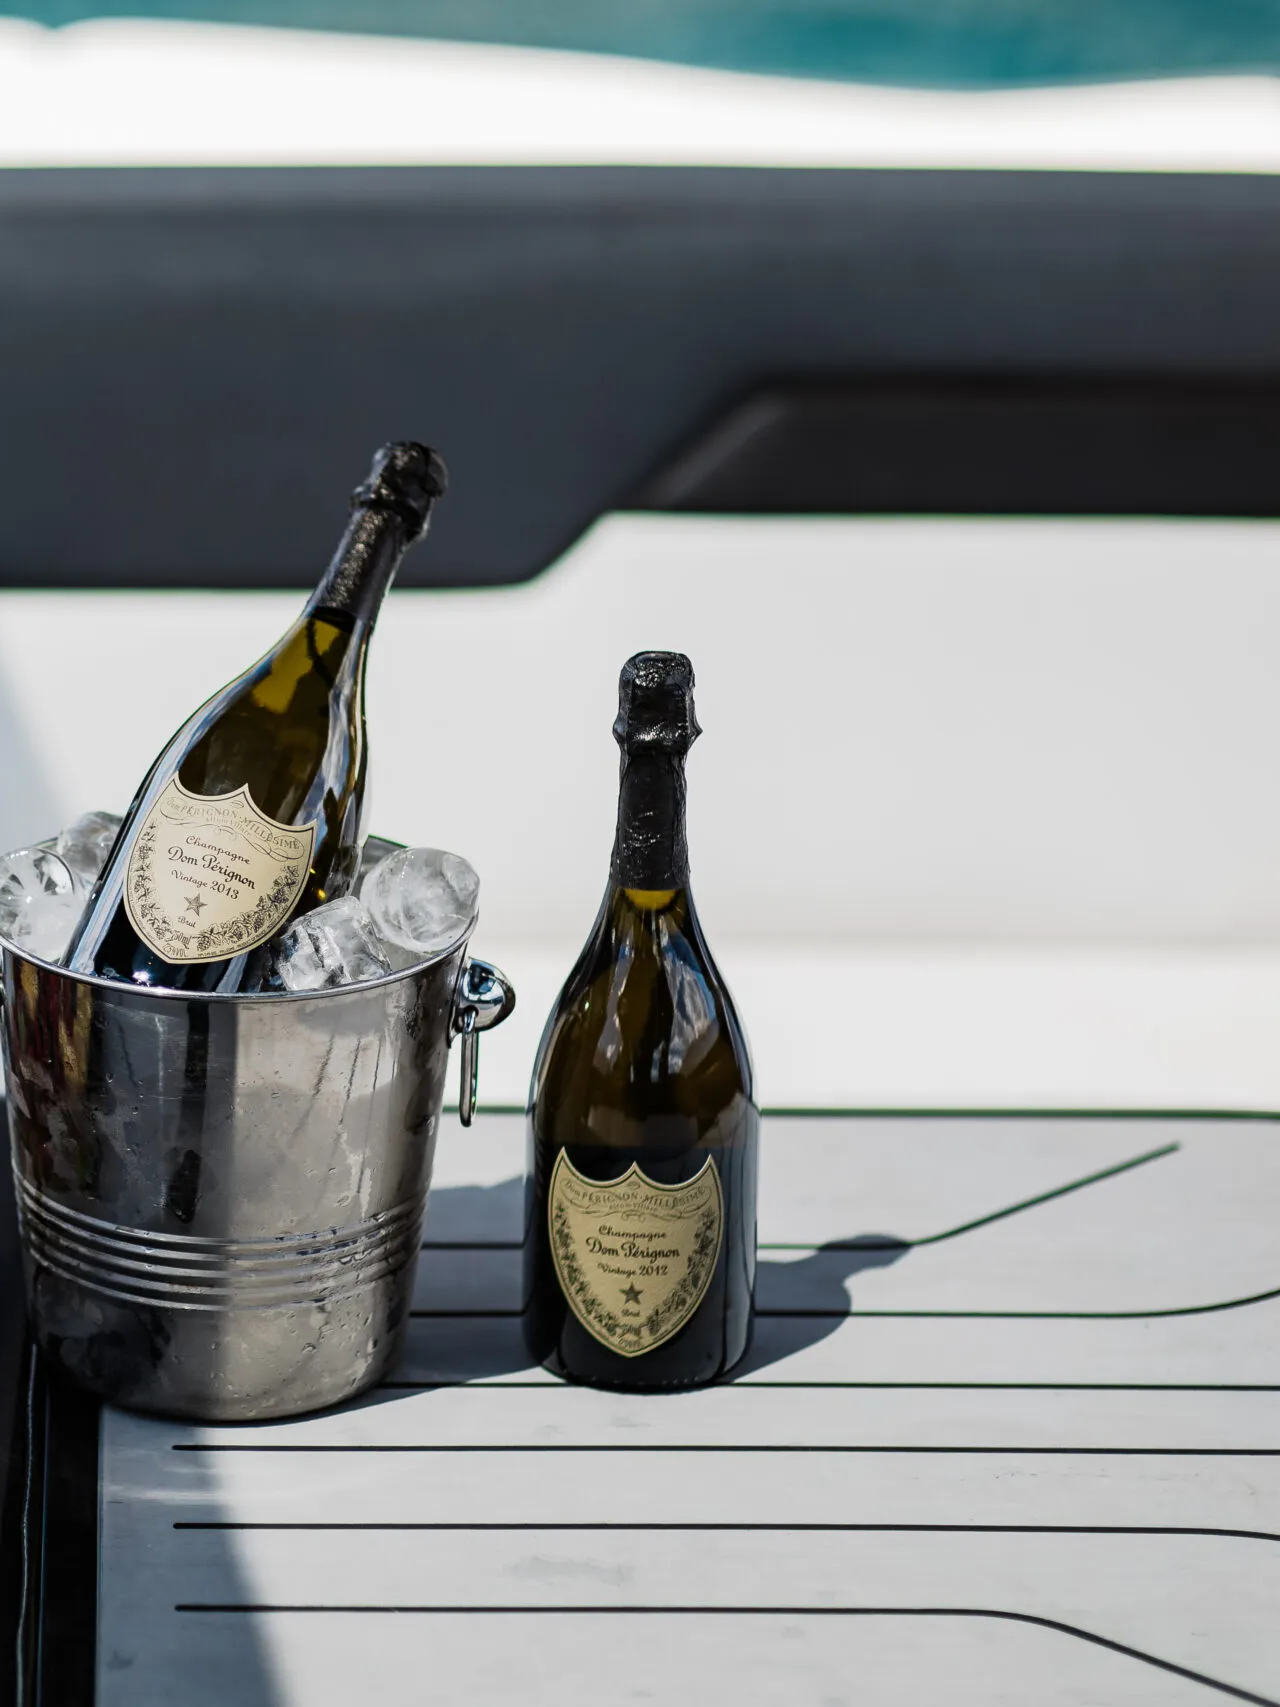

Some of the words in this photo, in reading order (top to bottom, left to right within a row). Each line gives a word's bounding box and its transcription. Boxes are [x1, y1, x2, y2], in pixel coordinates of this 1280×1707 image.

[185, 835, 250, 864] Champagne
[167, 845, 198, 866] Dom
[201, 854, 255, 889] Pérignon
[171, 869, 208, 888] Vintage
[210, 880, 239, 900] 2013
[178, 916, 196, 929] Brut
[598, 1224, 666, 1241] Champagne
[585, 1236, 619, 1256] Dom
[620, 1241, 680, 1264] Pérignon
[597, 1262, 636, 1278] Vintage
[638, 1265, 668, 1276] 2012
